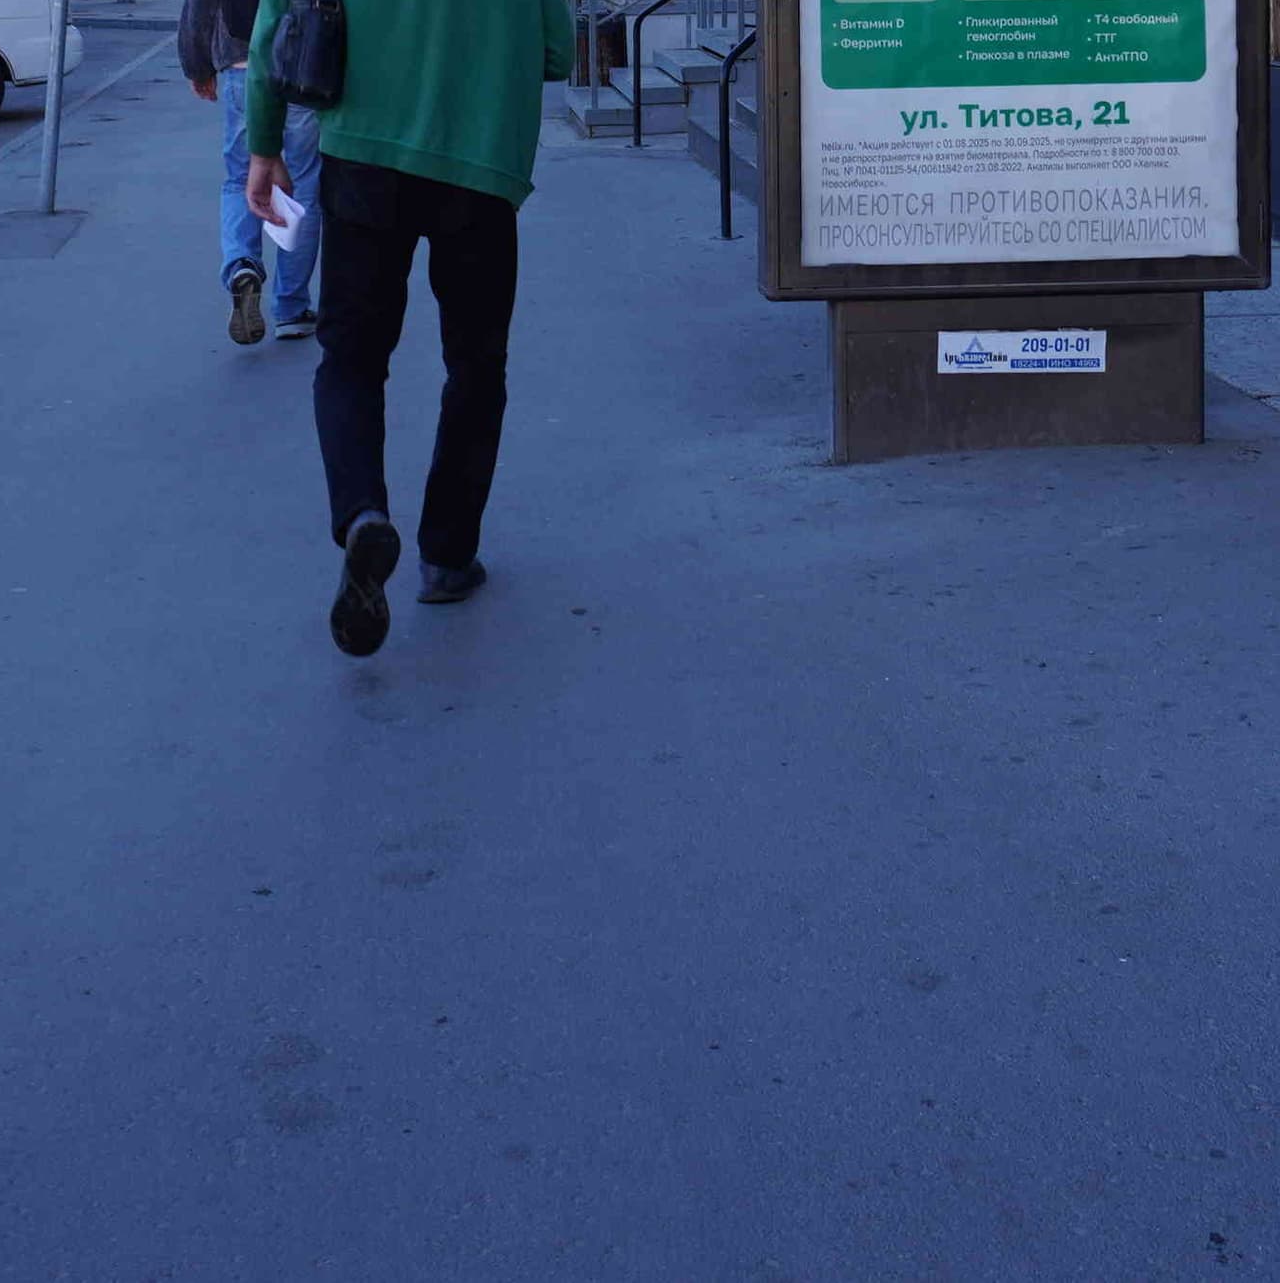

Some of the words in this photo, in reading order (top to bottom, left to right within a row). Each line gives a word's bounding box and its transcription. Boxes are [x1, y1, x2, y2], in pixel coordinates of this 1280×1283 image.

[840, 19, 893, 29] Витамин
[896, 19, 905, 28] D
[966, 15, 1058, 28] Гликированный
[1094, 14, 1109, 24] Т4
[1112, 12, 1179, 24] свободный
[967, 31, 1036, 42] гемоглобин
[1094, 33, 1117, 43] ТТГ
[841, 38, 903, 50] Ферритин
[966, 51, 1015, 61] Глюкоза
[1017, 52, 1024, 60] в
[1027, 50, 1070, 60] плазме
[1095, 51, 1149, 62] АнтиТПО
[900, 110, 948, 135] ул.
[958, 104, 1083, 130] Титова,
[1093, 100, 1130, 125] 21
[820, 193, 935, 216] ИМЕЮТСЯ
[950, 186, 1209, 214] ПРОТИВОПОКАЗАНИЯ.
[821, 216, 1034, 247] ПРОКОНСУЛЬТИРУЙТЕСЬ
[1039, 220, 1061, 242] СО
[1066, 216, 1207, 241] СПЕЦИАЛИСТОМ
[1022, 337, 1090, 352] 209-01-01
